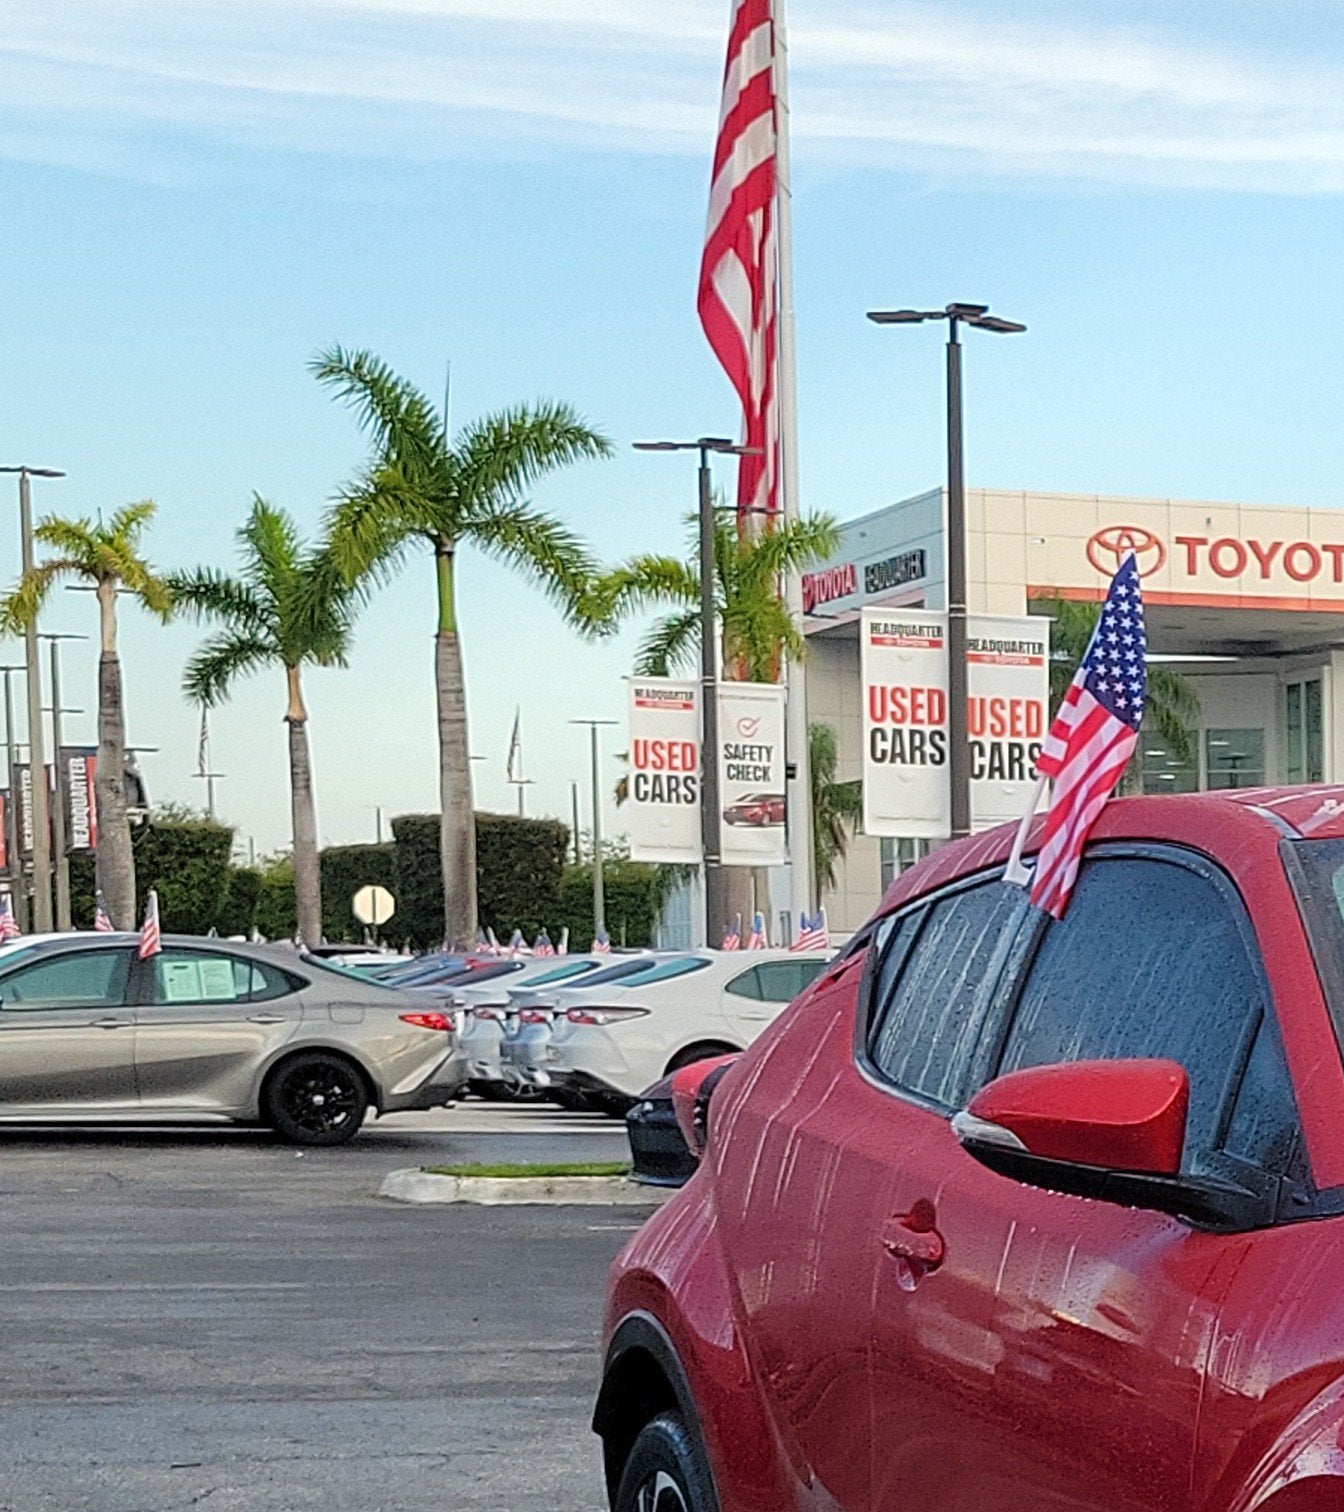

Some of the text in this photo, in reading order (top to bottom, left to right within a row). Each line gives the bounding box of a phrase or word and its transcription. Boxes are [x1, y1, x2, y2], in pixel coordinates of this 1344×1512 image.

[869, 686, 946, 725] USED
[968, 697, 1042, 738] USED
[633, 739, 696, 771] USED
[724, 744, 773, 762] SAFETY
[870, 728, 946, 765] CARS
[969, 740, 1043, 781] CARS
[634, 773, 697, 804] CARS
[727, 764, 771, 782] CHECK
